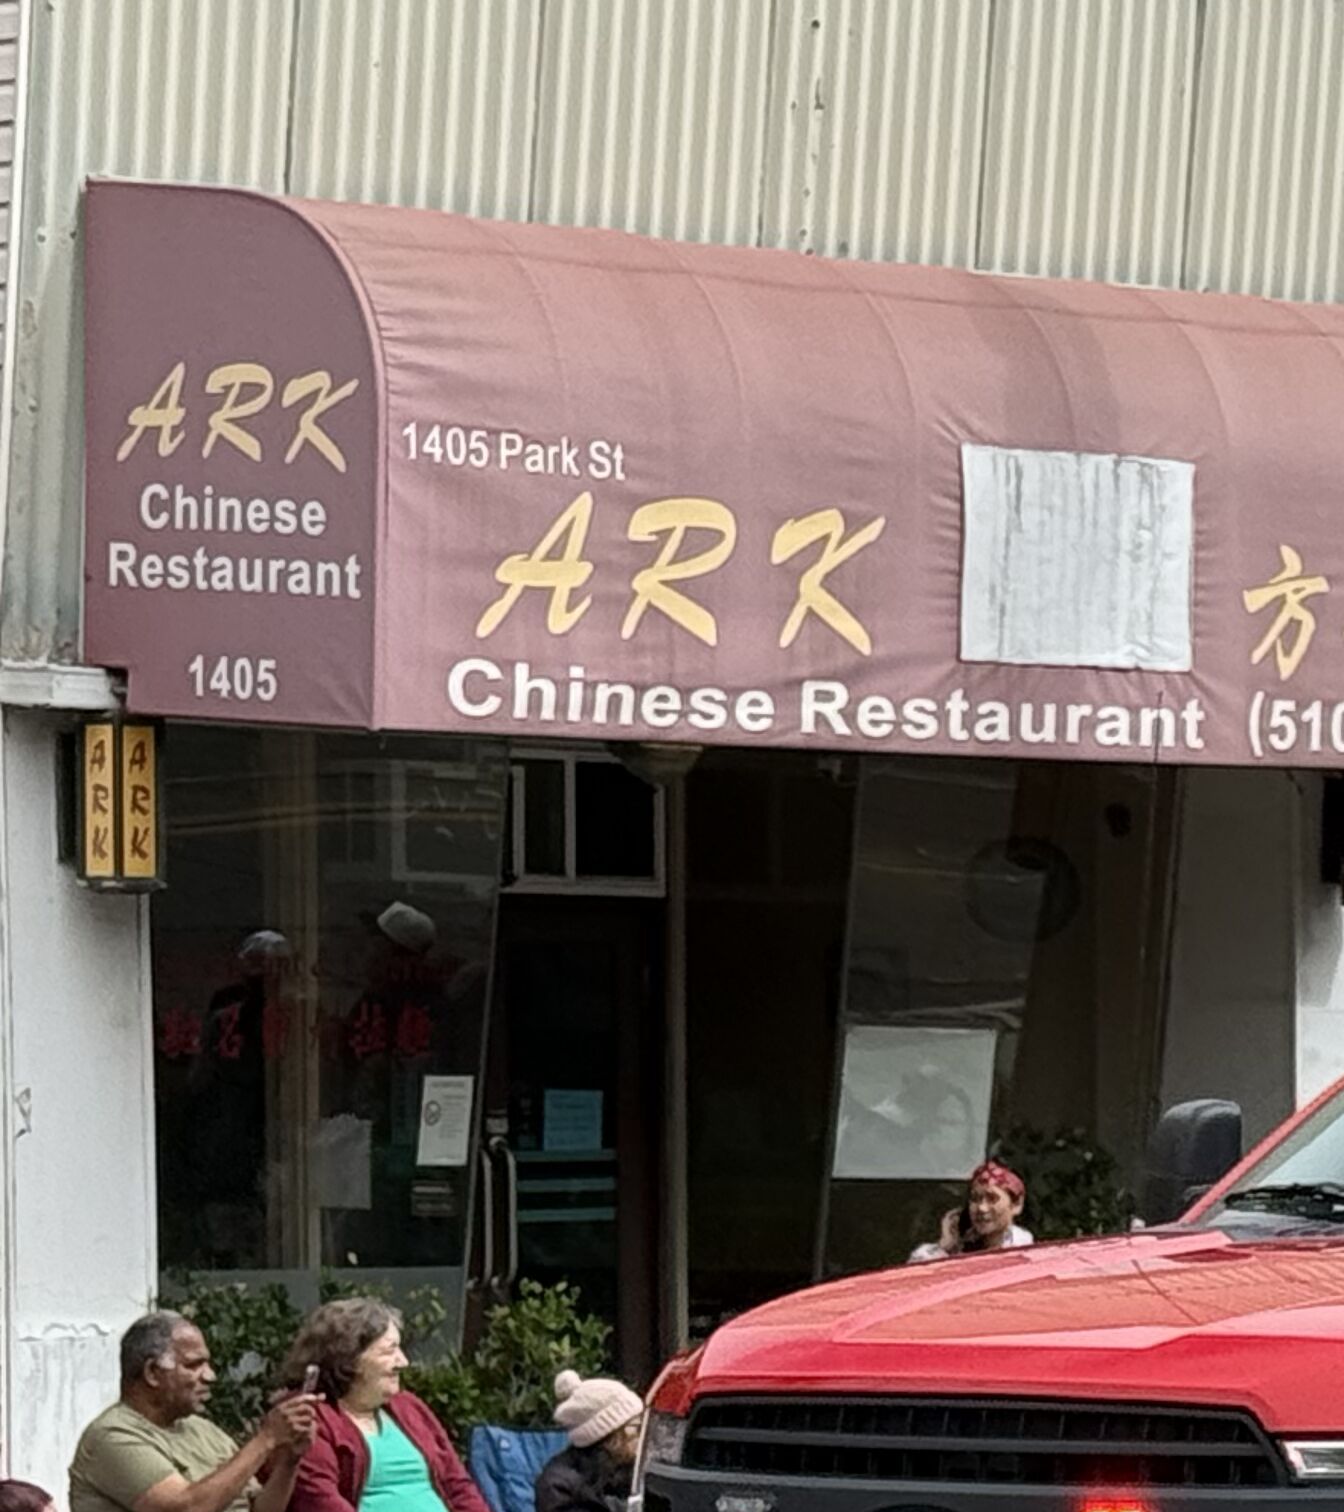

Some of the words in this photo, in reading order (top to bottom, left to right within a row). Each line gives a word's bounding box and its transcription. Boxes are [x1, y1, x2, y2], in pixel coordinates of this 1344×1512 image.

[115, 362, 361, 474] ARK
[402, 423, 490, 468] 1405
[499, 436, 579, 478] Park
[588, 441, 626, 481] St
[140, 483, 328, 536] Chinese
[108, 542, 362, 600] Restaurant
[475, 491, 886, 657] ARK
[188, 654, 278, 702] 1405
[447, 658, 775, 733] Chinese
[800, 680, 1205, 752] Restaurant
[89, 738, 109, 860] ARK
[129, 738, 151, 861] ARK
